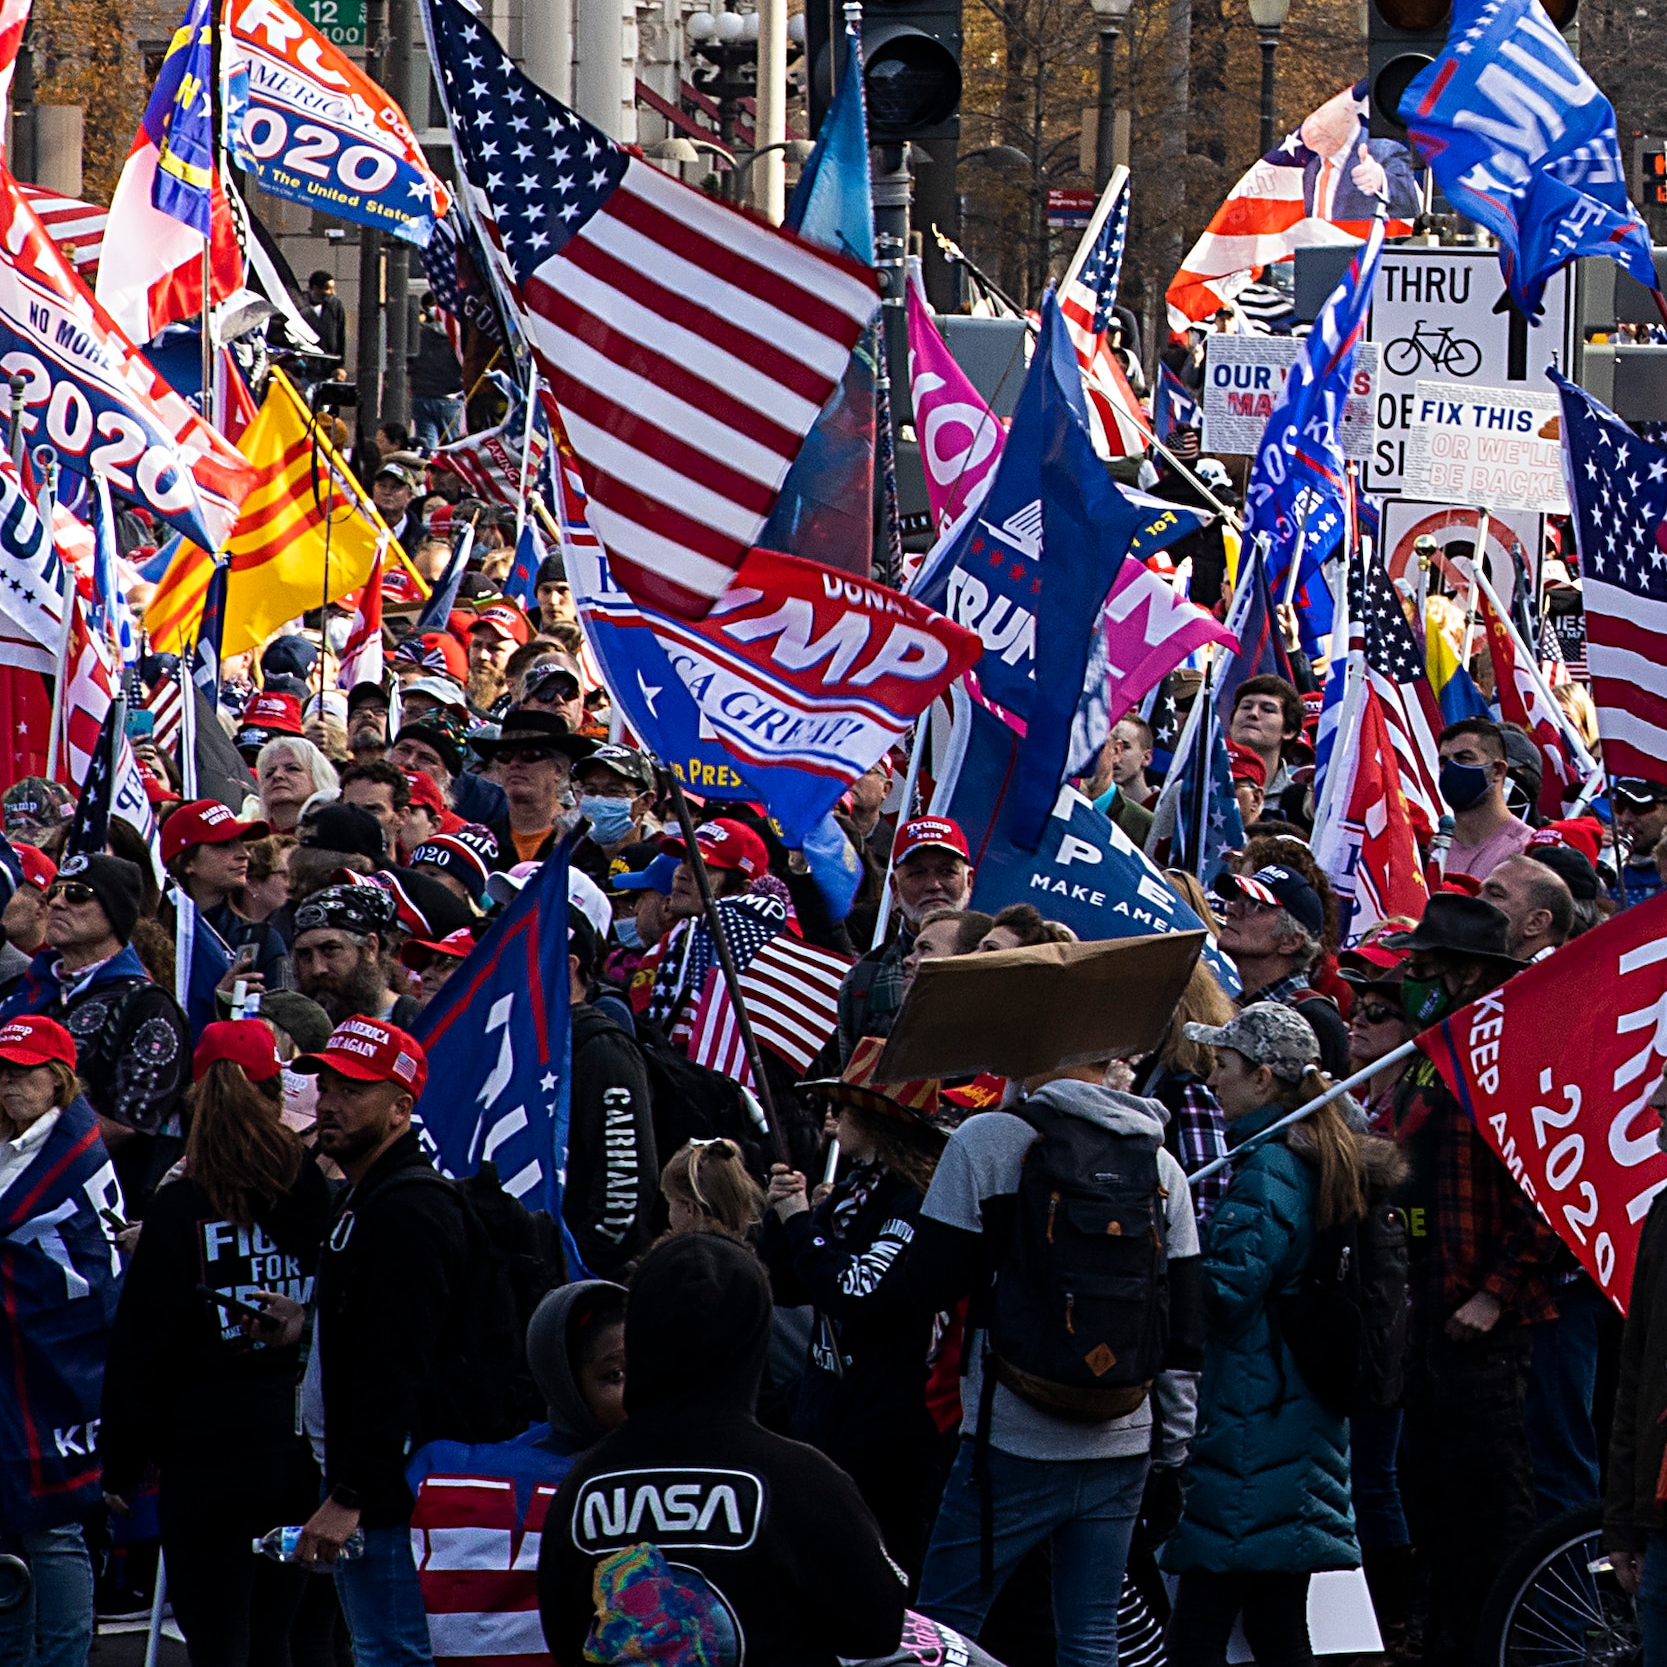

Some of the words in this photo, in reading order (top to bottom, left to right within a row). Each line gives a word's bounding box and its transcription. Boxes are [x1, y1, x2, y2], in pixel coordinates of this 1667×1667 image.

[309, 1, 339, 24] 12
[240, 109, 398, 194] 020
[273, 169, 301, 188] The
[307, 179, 359, 208] United
[1382, 264, 1473, 305] THRU
[28, 299, 50, 329] NO
[1212, 363, 1271, 392] OUR
[1420, 400, 1464, 425] FIX
[1473, 405, 1534, 432] THIS
[484, 438, 520, 483] AKING
[1431, 433, 1474, 461] OR
[1429, 462, 1466, 489] BE
[1470, 466, 1555, 497] BACK!
[720, 692, 866, 757] GREAT!
[906, 820, 952, 834] Trump
[1030, 873, 1107, 907] MAKE
[345, 1020, 390, 1045] AMERICA
[345, 1039, 378, 1058] AGAIN
[1468, 989, 1504, 1094] KEEP
[250, 1254, 300, 1282] FOR
[583, 1484, 743, 1540] NASA
